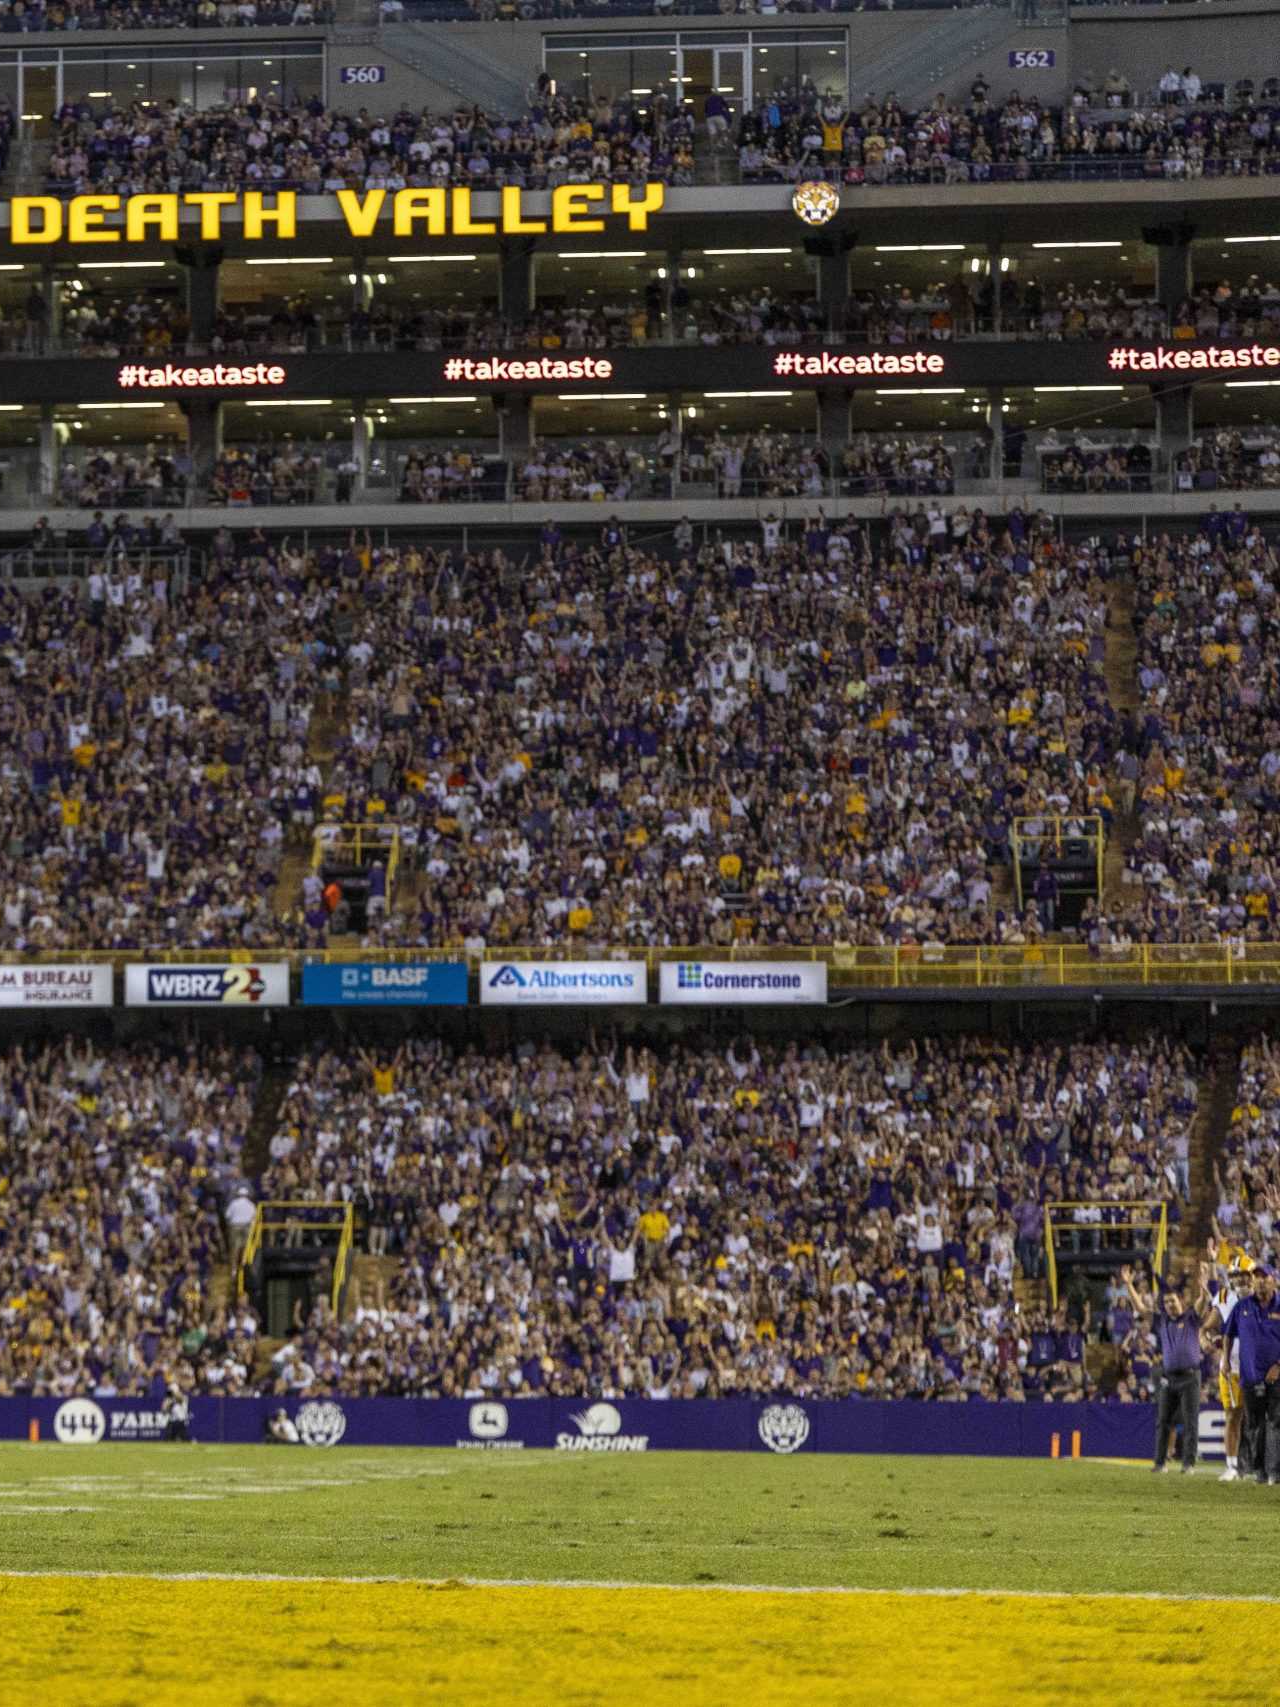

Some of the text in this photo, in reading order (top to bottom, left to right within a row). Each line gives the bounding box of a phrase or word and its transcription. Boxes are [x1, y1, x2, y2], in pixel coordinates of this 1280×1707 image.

[1015, 51, 1049, 68] 562
[346, 67, 380, 83] 560
[11, 191, 297, 244] DEATH
[337, 183, 664, 237] VALLEY
[773, 352, 945, 376] #takeataste
[1108, 345, 1280, 370] #takeataste
[118, 364, 285, 388] #takeataste
[443, 356, 613, 381] #takeataste
[22, 969, 93, 986] BUREAU
[150, 974, 222, 998] WBRZ
[222, 967, 252, 1005] 2
[371, 967, 429, 987] BASF
[529, 969, 634, 988] Albertsons
[703, 972, 802, 989] Cornerstone
[61, 1414, 99, 1435] 44
[556, 1432, 649, 1451] SUNSHINE
